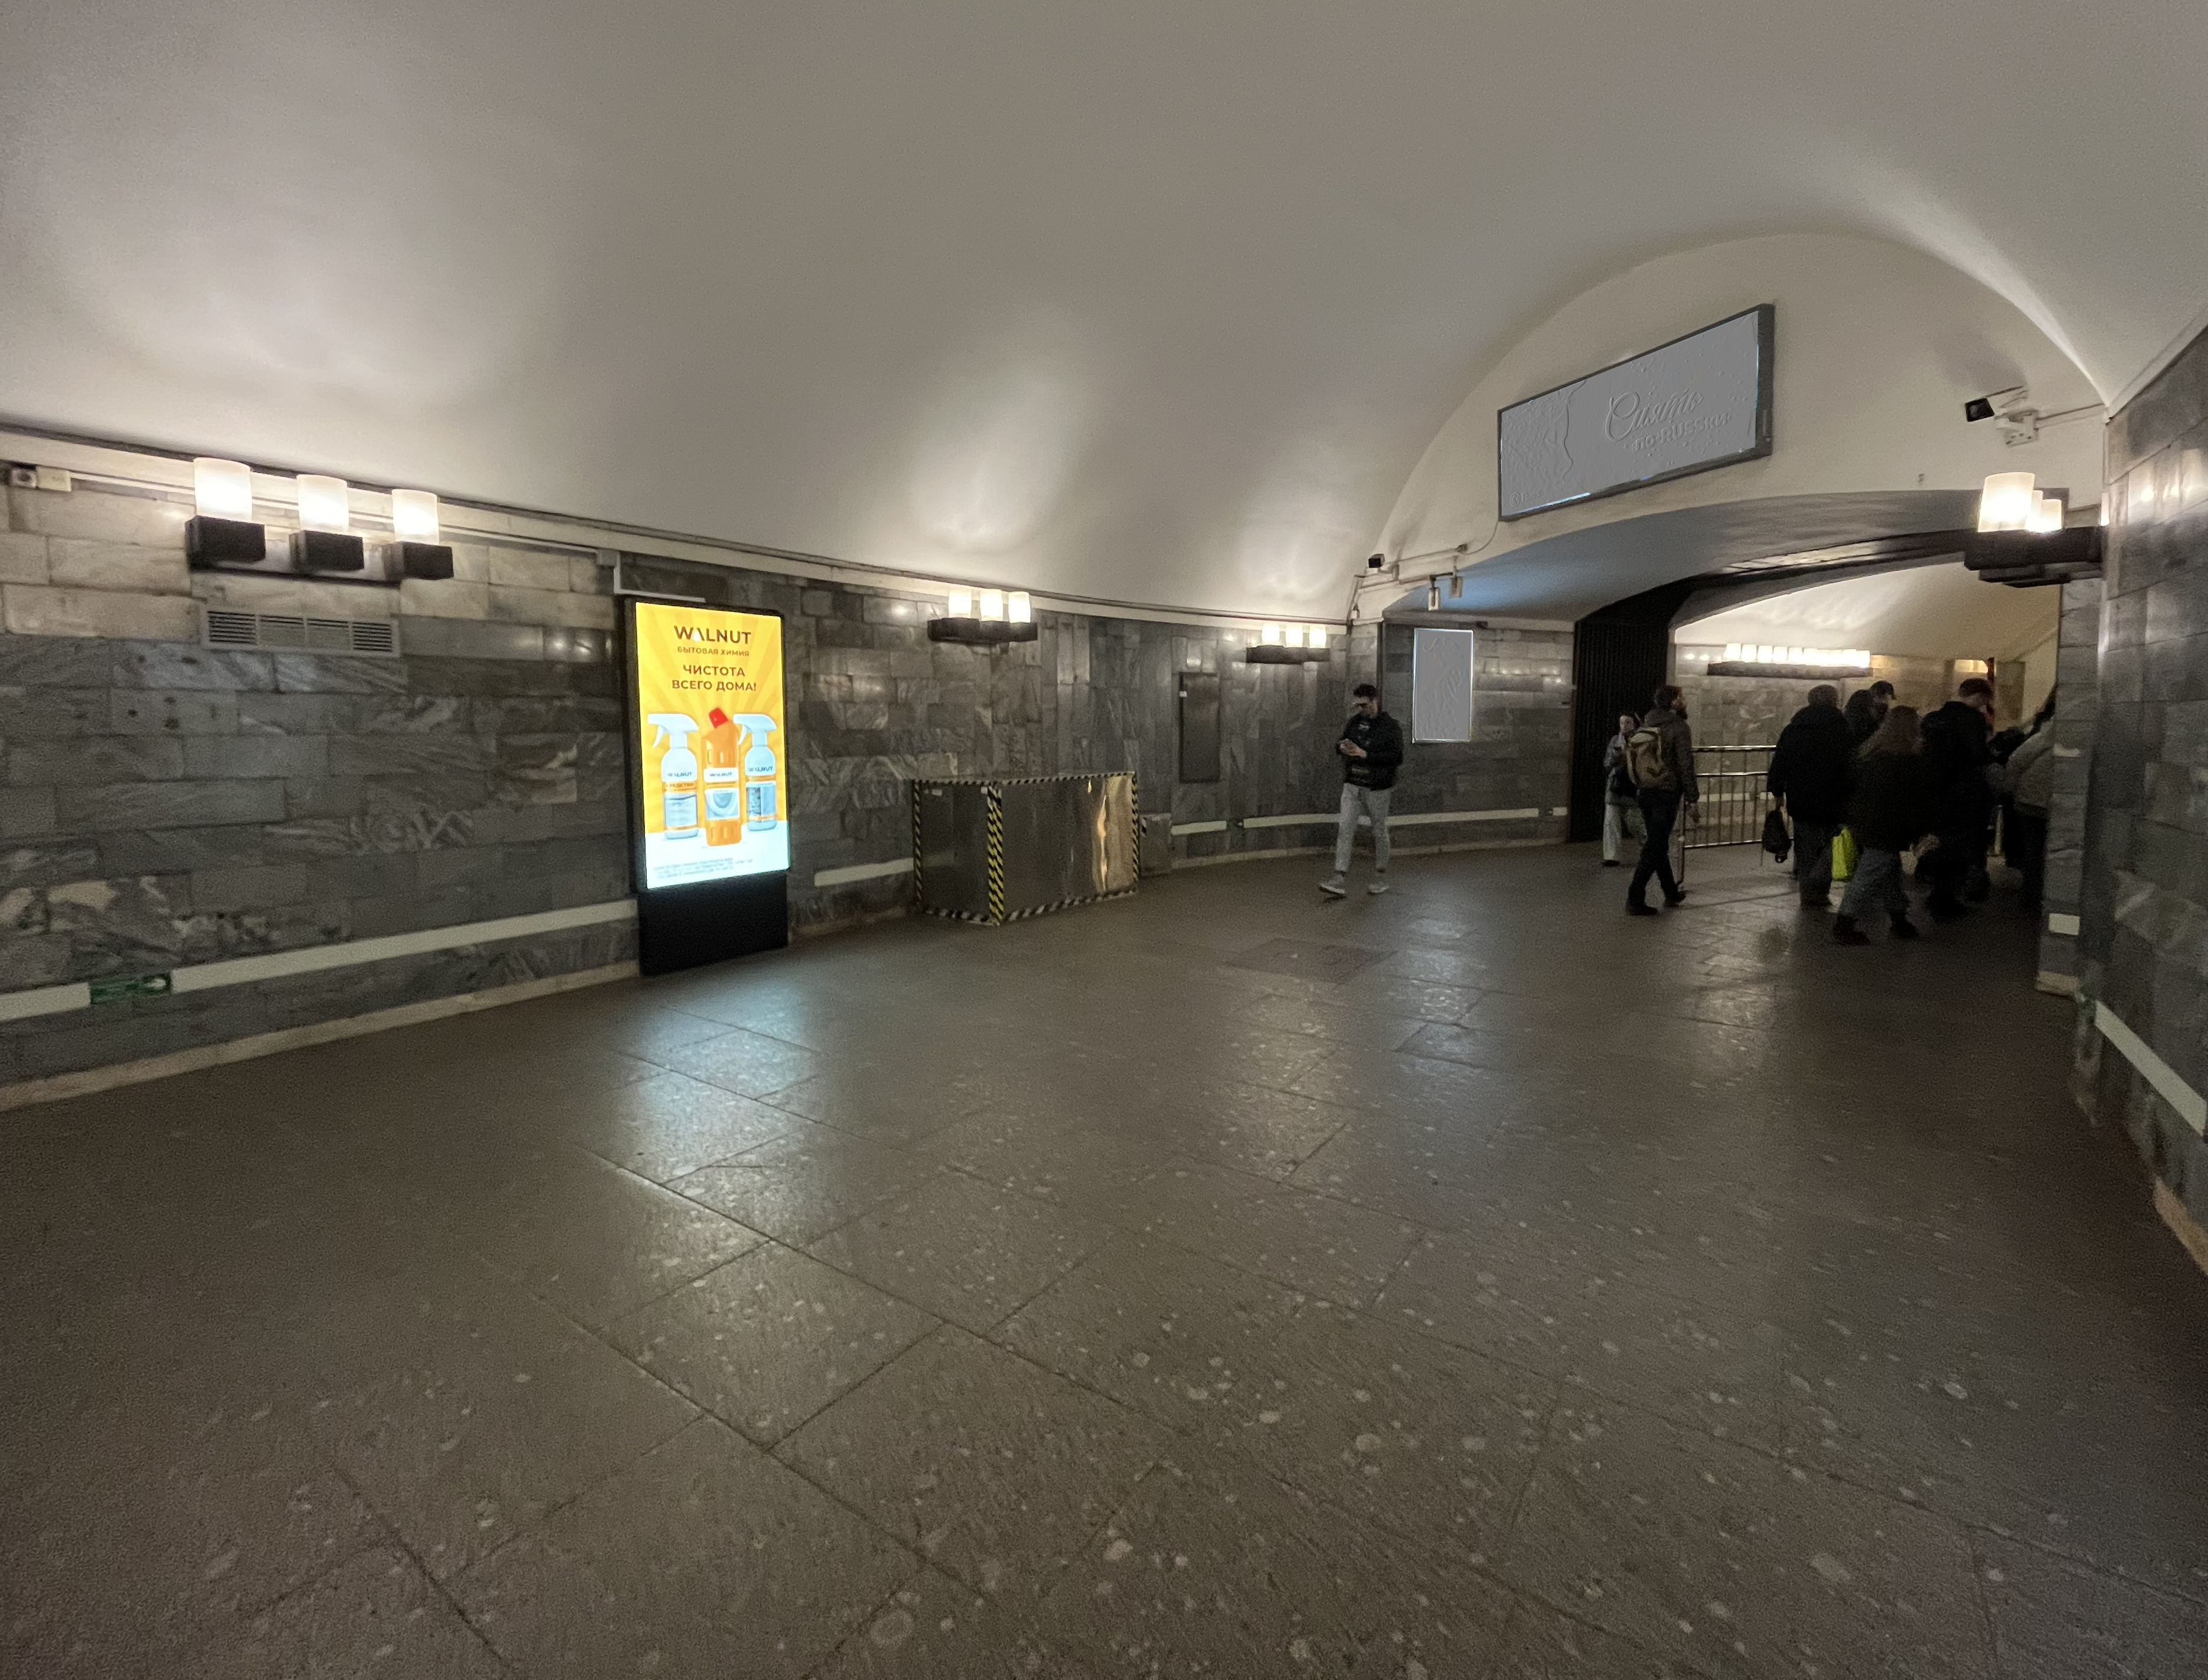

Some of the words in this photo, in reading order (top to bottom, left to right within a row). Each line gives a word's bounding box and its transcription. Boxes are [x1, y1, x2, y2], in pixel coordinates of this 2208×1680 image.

[1605, 388, 1704, 442] Сиять
[673, 625, 751, 645] WALNUT
[677, 646, 719, 655] БЫТОВАЯ
[683, 664, 746, 677] ЧИСТОТА
[671, 680, 713, 690] ВСЕГО
[716, 681, 757, 692] ДОМА!
